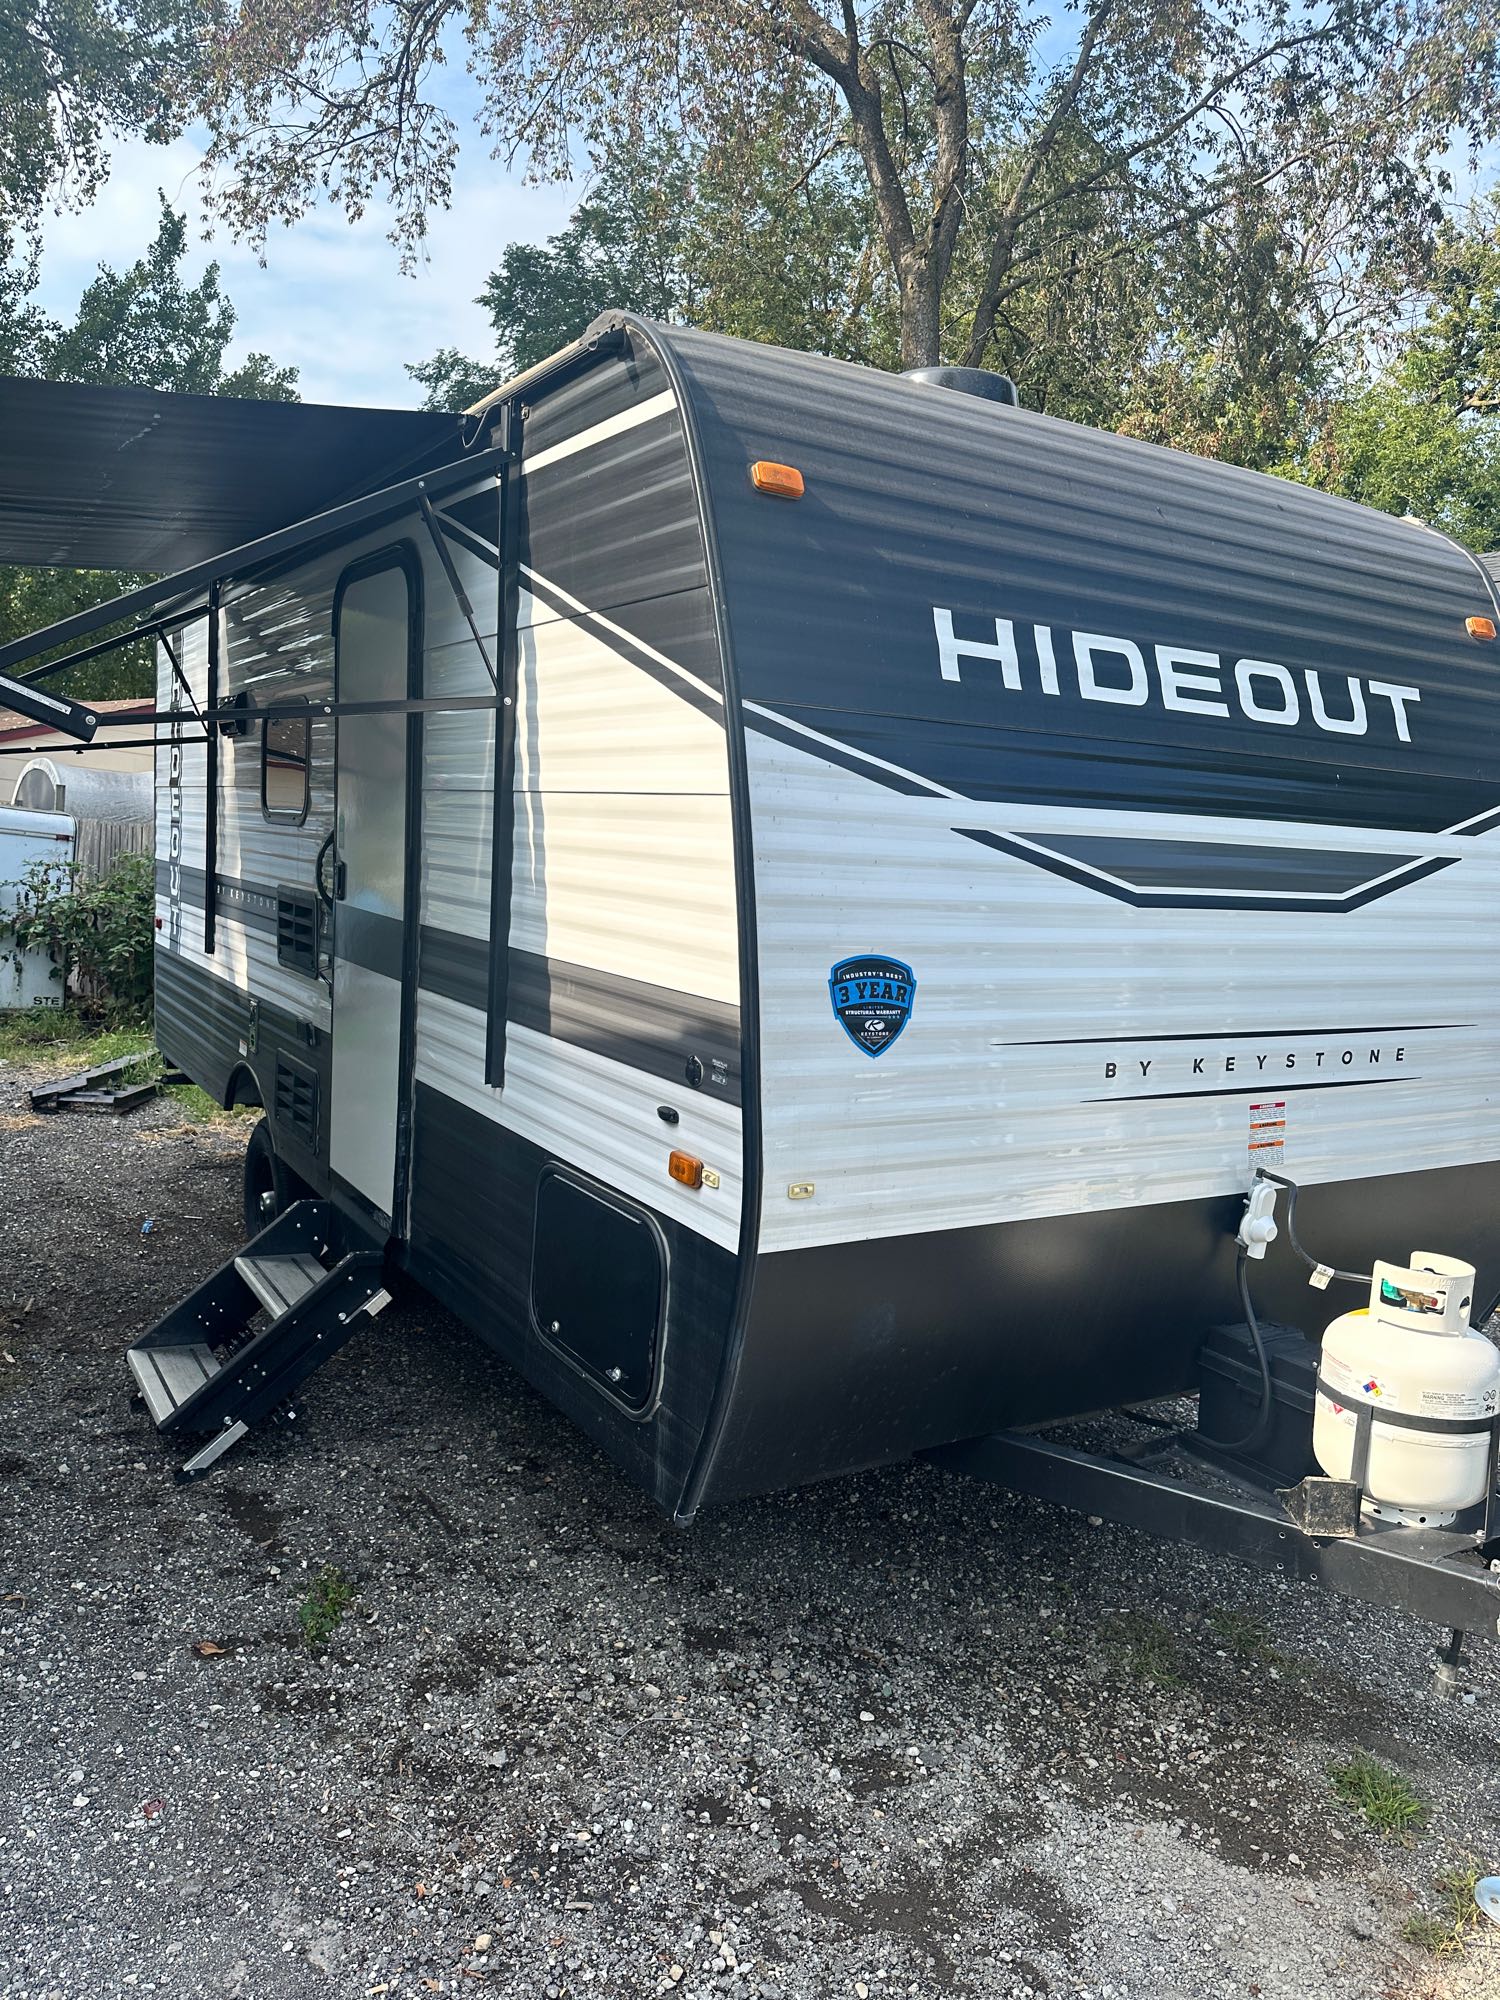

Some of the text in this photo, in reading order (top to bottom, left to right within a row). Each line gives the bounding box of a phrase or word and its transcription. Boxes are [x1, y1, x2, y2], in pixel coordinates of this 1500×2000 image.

[932, 606, 1422, 743] HIDEOUT
[230, 888, 276, 911] KEYSTONE
[843, 971, 903, 980] INDUSTRY'S BEST
[33, 996, 60, 1006] STE
[838, 981, 908, 1004] 3 YEAR
[1105, 1048, 1405, 1079] BY KEYSTONE
